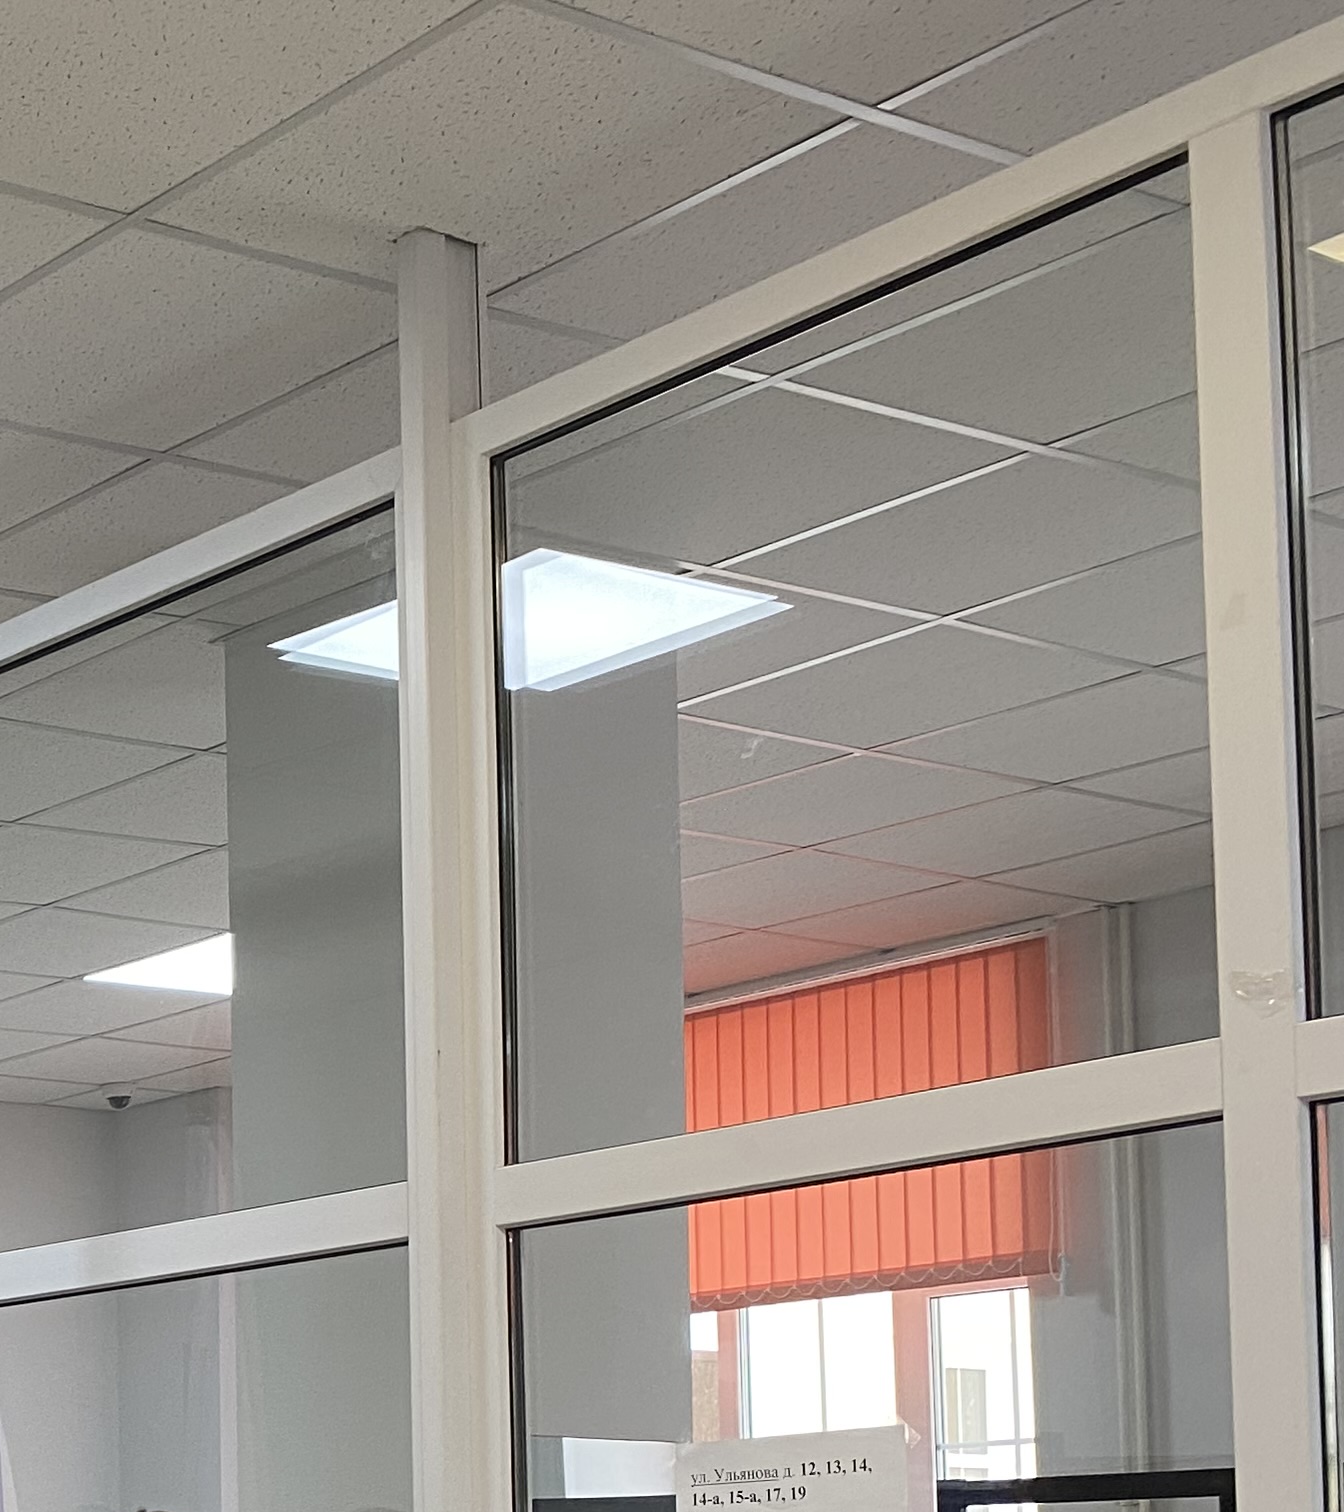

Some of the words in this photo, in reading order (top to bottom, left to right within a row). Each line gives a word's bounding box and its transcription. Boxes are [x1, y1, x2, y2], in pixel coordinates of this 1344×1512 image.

[691, 1473, 711, 1486] ул.
[714, 1468, 779, 1482] Ульянова
[801, 1461, 821, 1477] 12,
[826, 1460, 847, 1475] 13,
[851, 1458, 873, 1474] 14,
[692, 1492, 725, 1506] 14-а,
[729, 1490, 762, 1505] 15-а,
[766, 1487, 786, 1503] 17,
[791, 1486, 807, 1500] 19
